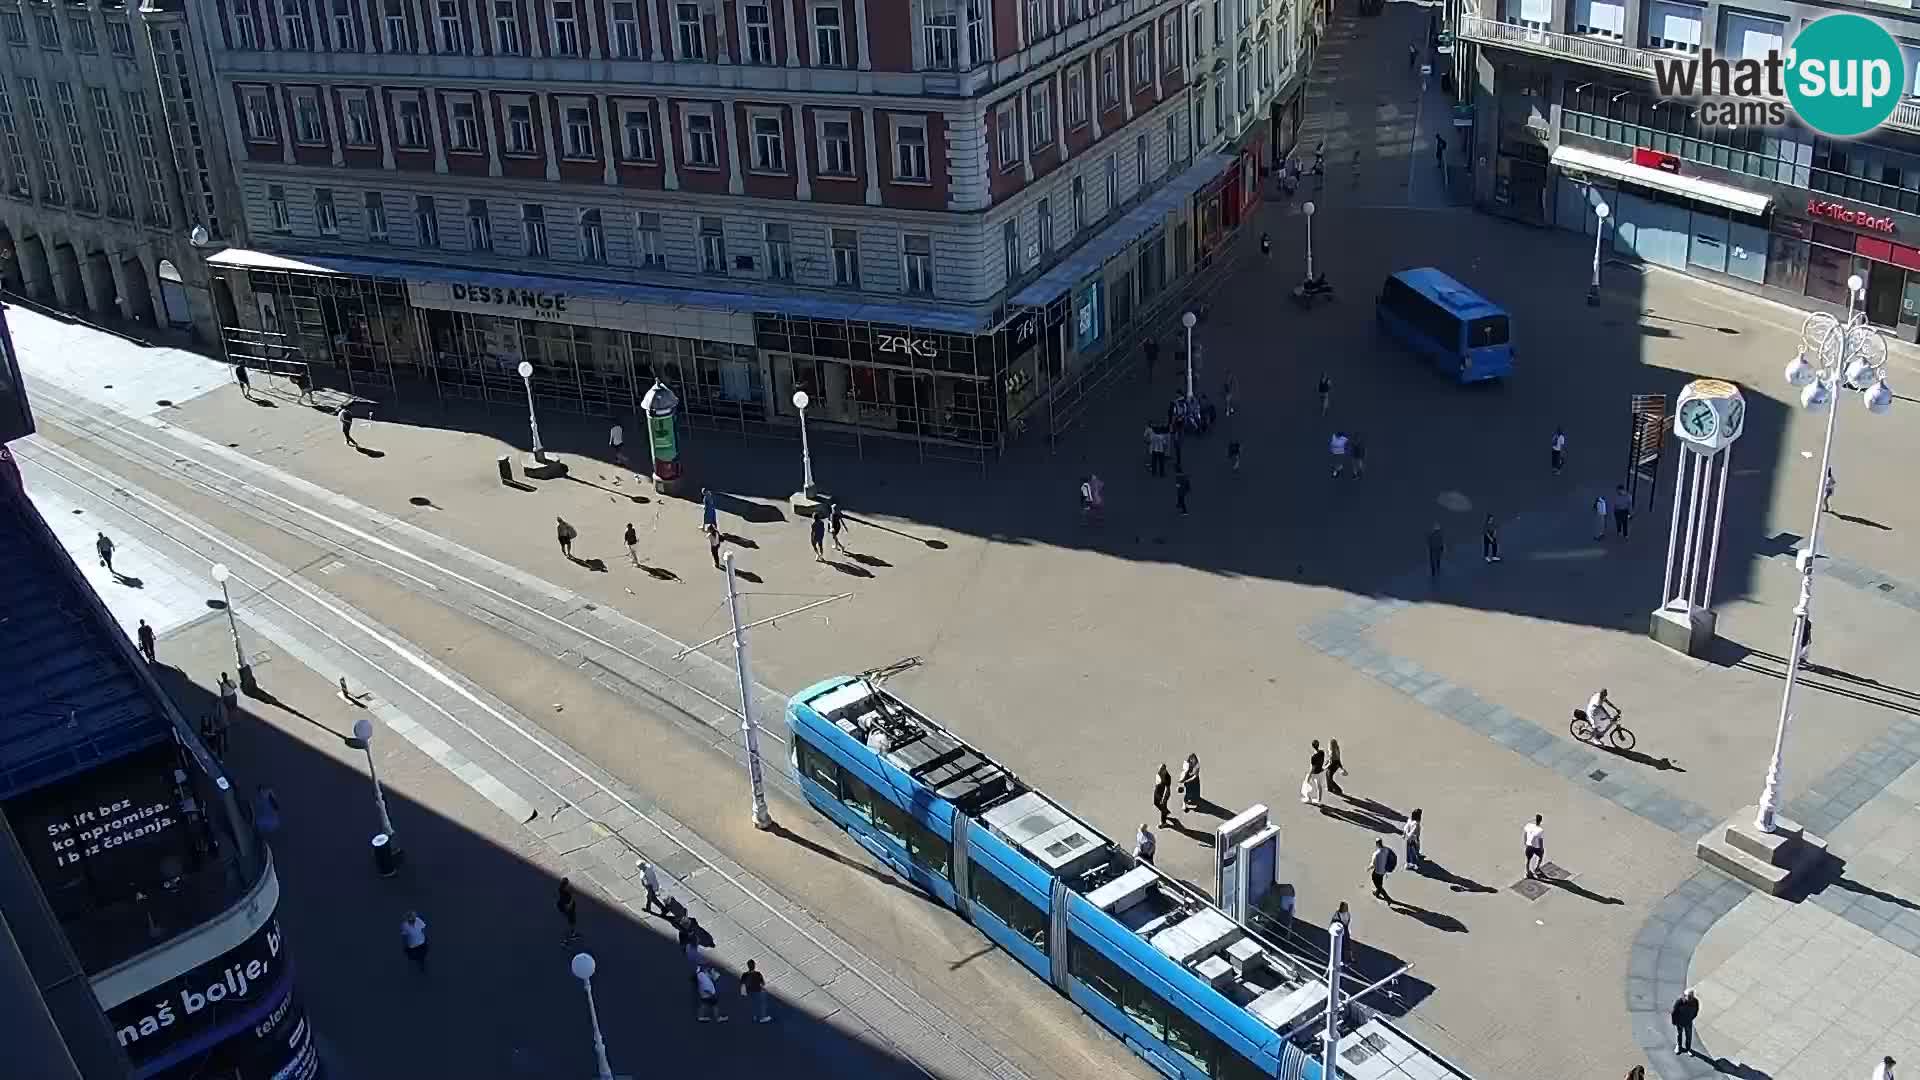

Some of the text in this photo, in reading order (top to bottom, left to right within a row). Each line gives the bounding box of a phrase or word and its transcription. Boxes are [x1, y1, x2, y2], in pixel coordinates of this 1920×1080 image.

[1856, 211, 1895, 233] Bank
[453, 283, 566, 312] DESSANGE
[877, 334, 937, 357] ZAKS
[99, 800, 131, 816] bez
[103, 817, 177, 849] čekanja.
[116, 1000, 176, 1047] naš
[180, 959, 268, 1015] bolje,
